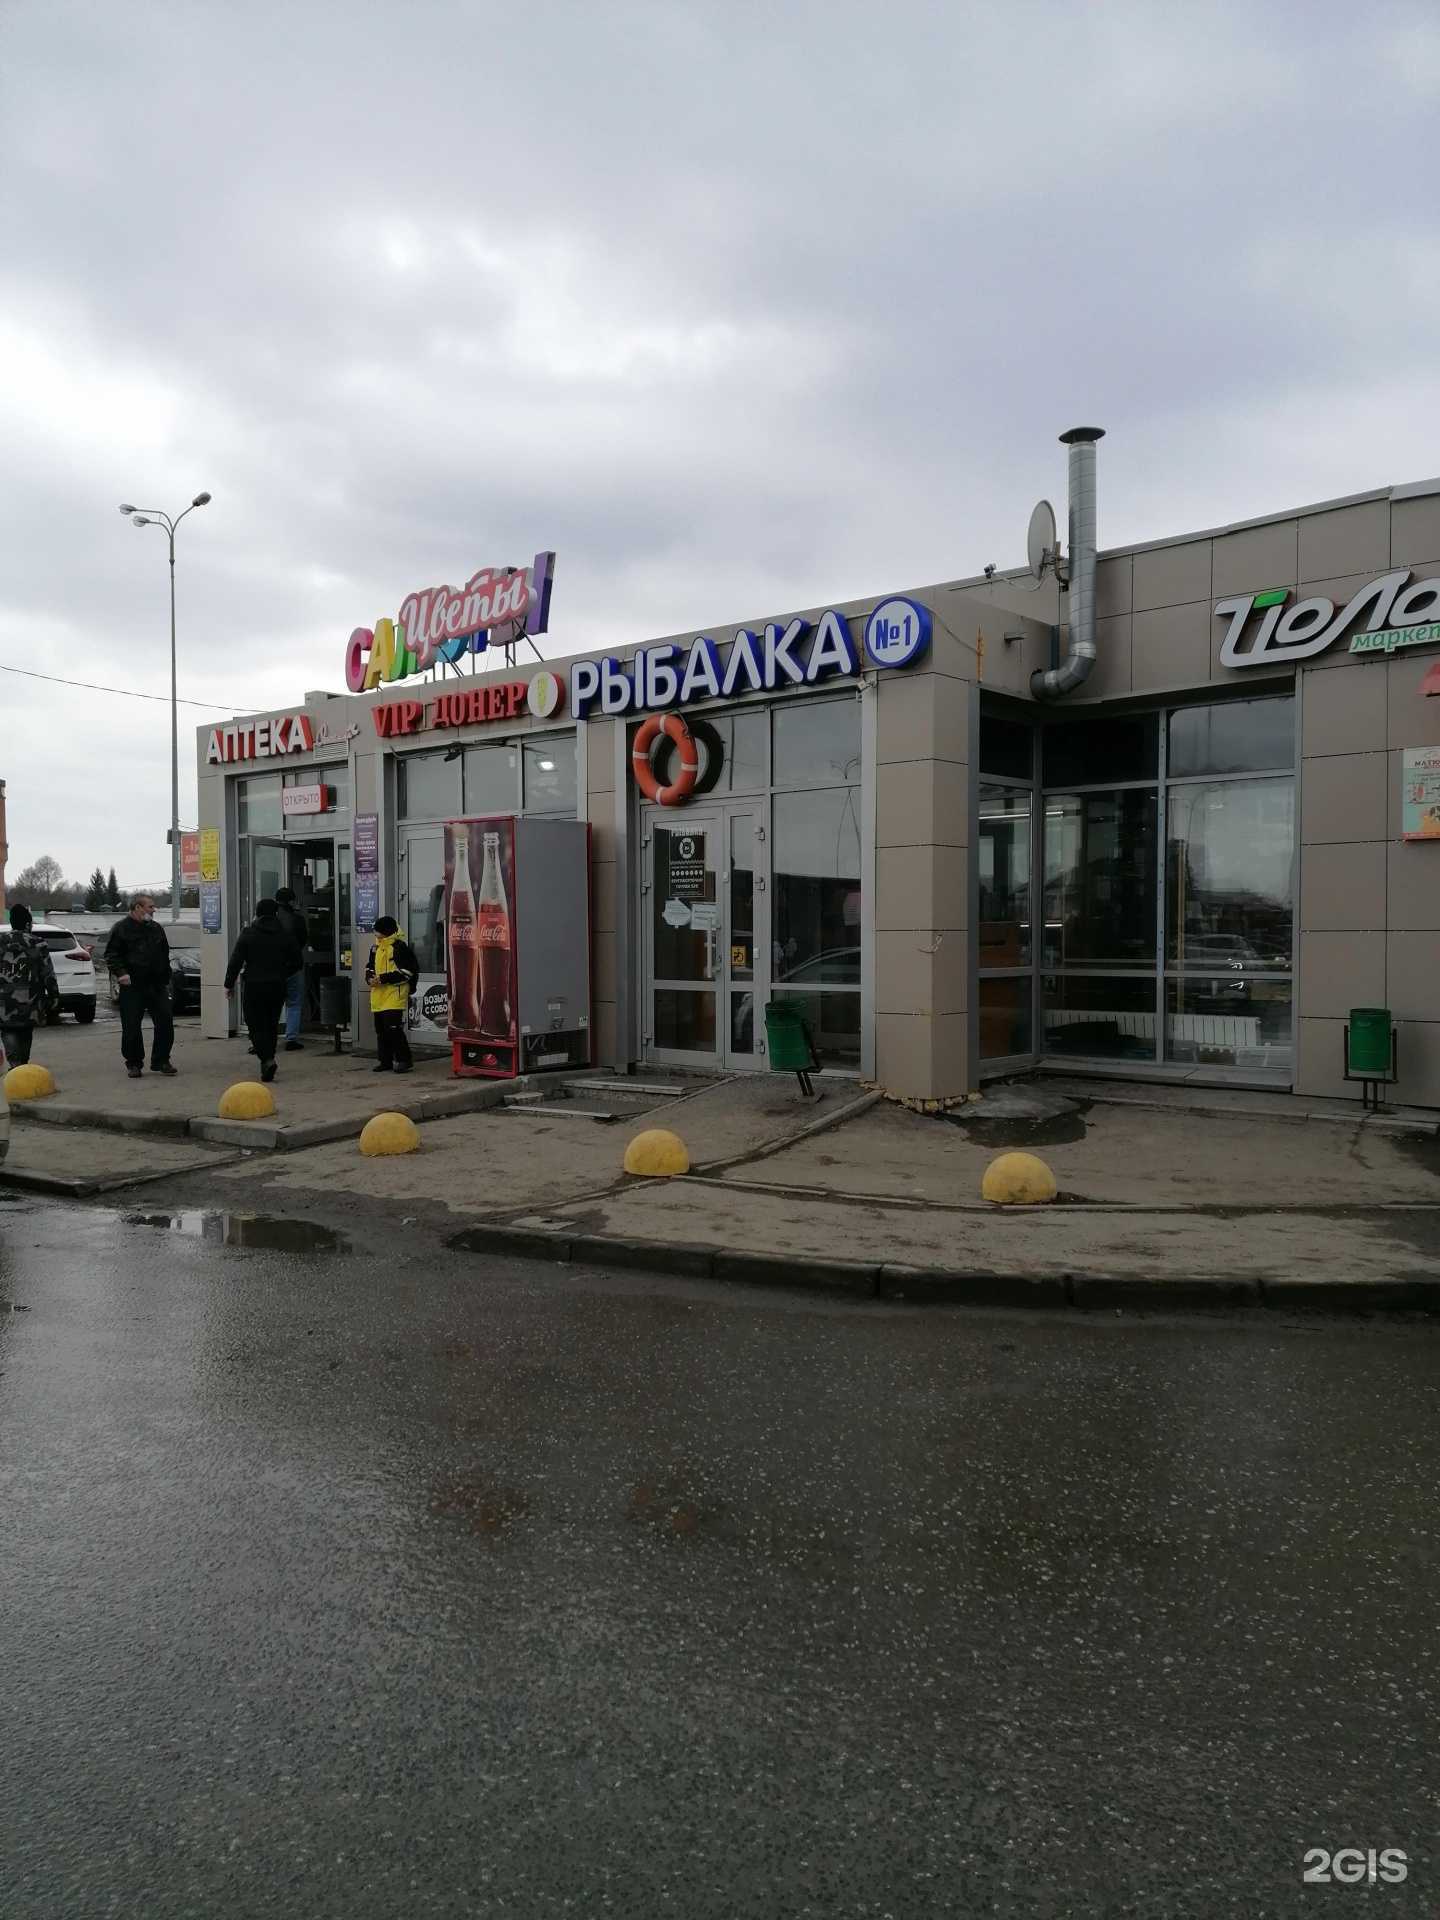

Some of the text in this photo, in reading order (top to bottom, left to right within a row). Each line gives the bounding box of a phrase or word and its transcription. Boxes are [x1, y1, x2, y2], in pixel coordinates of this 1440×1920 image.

[402, 575, 527, 661] Цветы
[570, 609, 858, 720] РЫБАЛКА
[874, 614, 914, 651] №1
[371, 700, 424, 738] VIP
[431, 682, 532, 728] ДОНЕР
[206, 713, 311, 764] АПТЕКА
[424, 993, 448, 1005] ВОЗЬМ
[431, 1004, 448, 1013] СОБО
